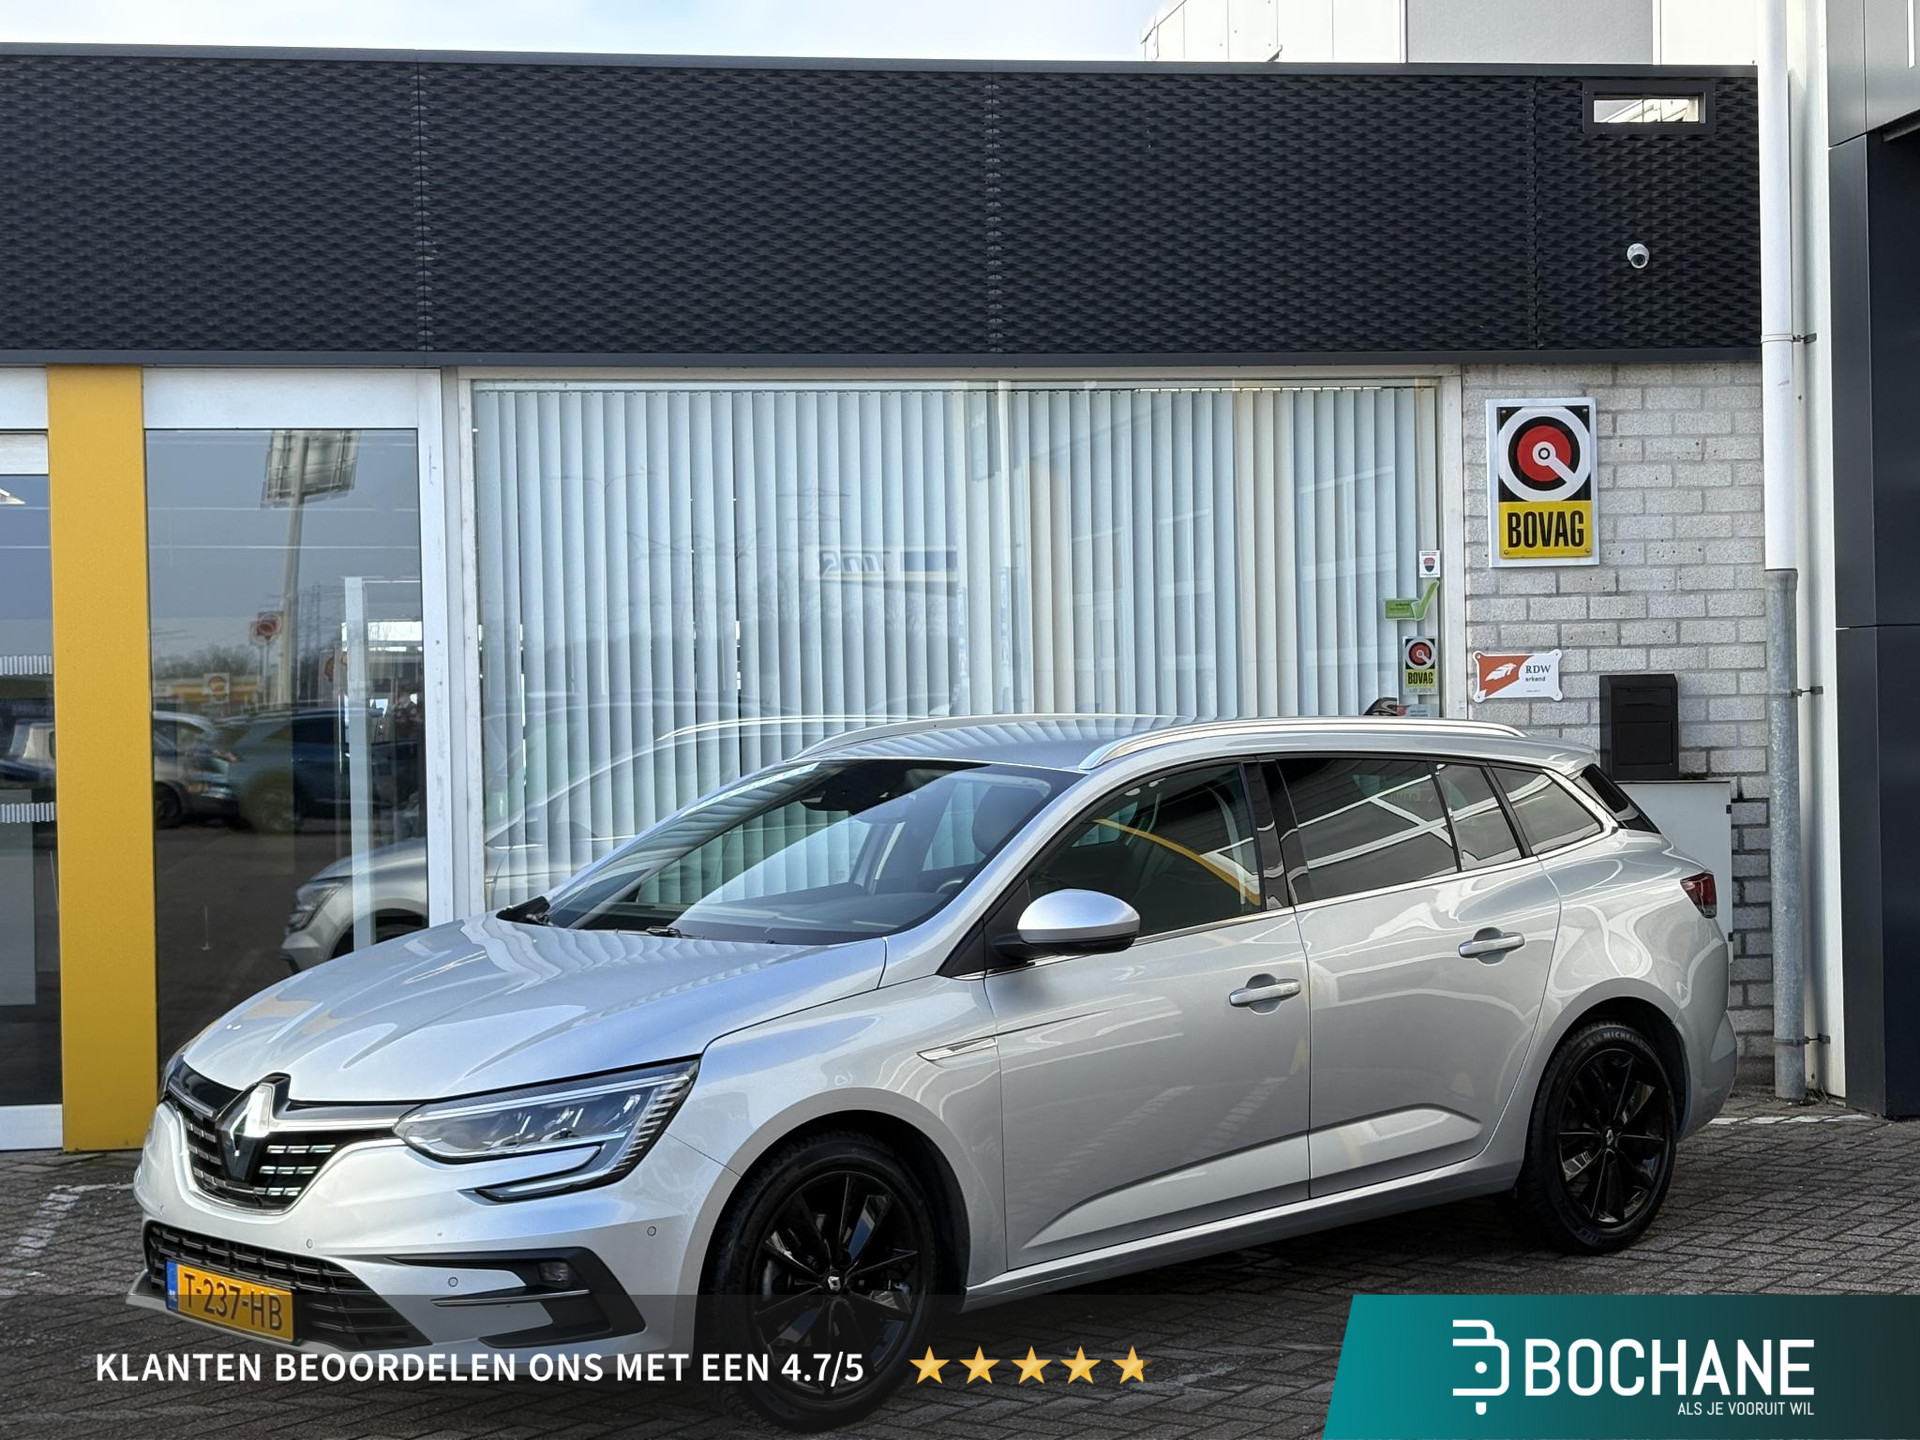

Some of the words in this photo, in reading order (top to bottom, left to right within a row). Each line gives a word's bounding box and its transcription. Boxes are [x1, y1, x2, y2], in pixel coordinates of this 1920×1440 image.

[1507, 510, 1585, 548] BOVAG
[1407, 671, 1434, 685] BOVAG
[1525, 664, 1551, 674] RDW
[184, 1272, 283, 1331] T-237-HB
